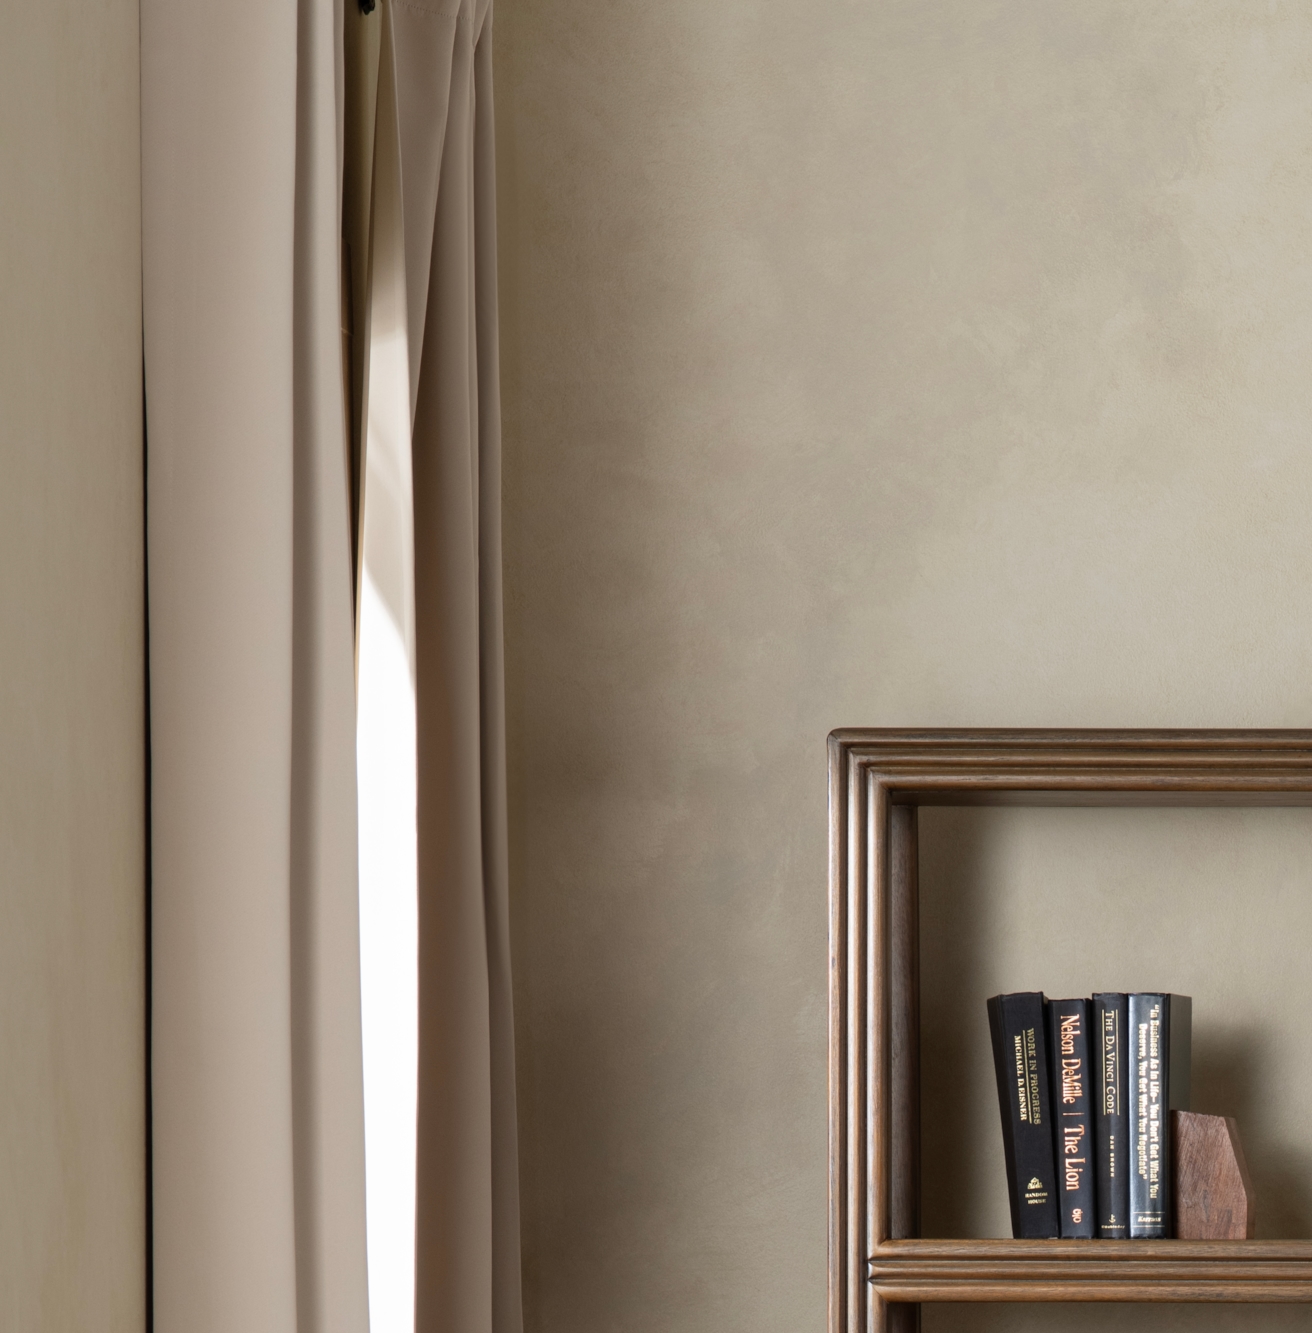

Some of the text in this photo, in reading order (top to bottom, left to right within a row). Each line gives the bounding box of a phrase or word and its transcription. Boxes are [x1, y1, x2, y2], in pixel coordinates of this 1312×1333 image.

[1105, 1010, 1115, 1031] THE
[1060, 1014, 1081, 1055] Nelson
[1150, 1020, 1160, 1057] Business
[1106, 1051, 1116, 1082] VINCI
[1138, 1060, 1148, 1076] You
[1150, 1058, 1159, 1070] As
[1150, 1070, 1159, 1080] In
[1014, 1035, 1027, 1121] MICHAEL D. EISNER
[1027, 1028, 1041, 1125] WORK IN PROGRESS
[1062, 1058, 1083, 1104] DeMille
[1138, 1077, 1148, 1093] Get
[1106, 1086, 1116, 1114] CODE
[1138, 1094, 1148, 1117] What
[1150, 1104, 1159, 1119] You
[1138, 1117, 1148, 1133] You
[1064, 1124, 1085, 1154] The
[1150, 1144, 1159, 1159] Get
[1065, 1157, 1086, 1191] Lion
[1150, 1160, 1159, 1182] What
[1150, 1184, 1159, 1199] You
